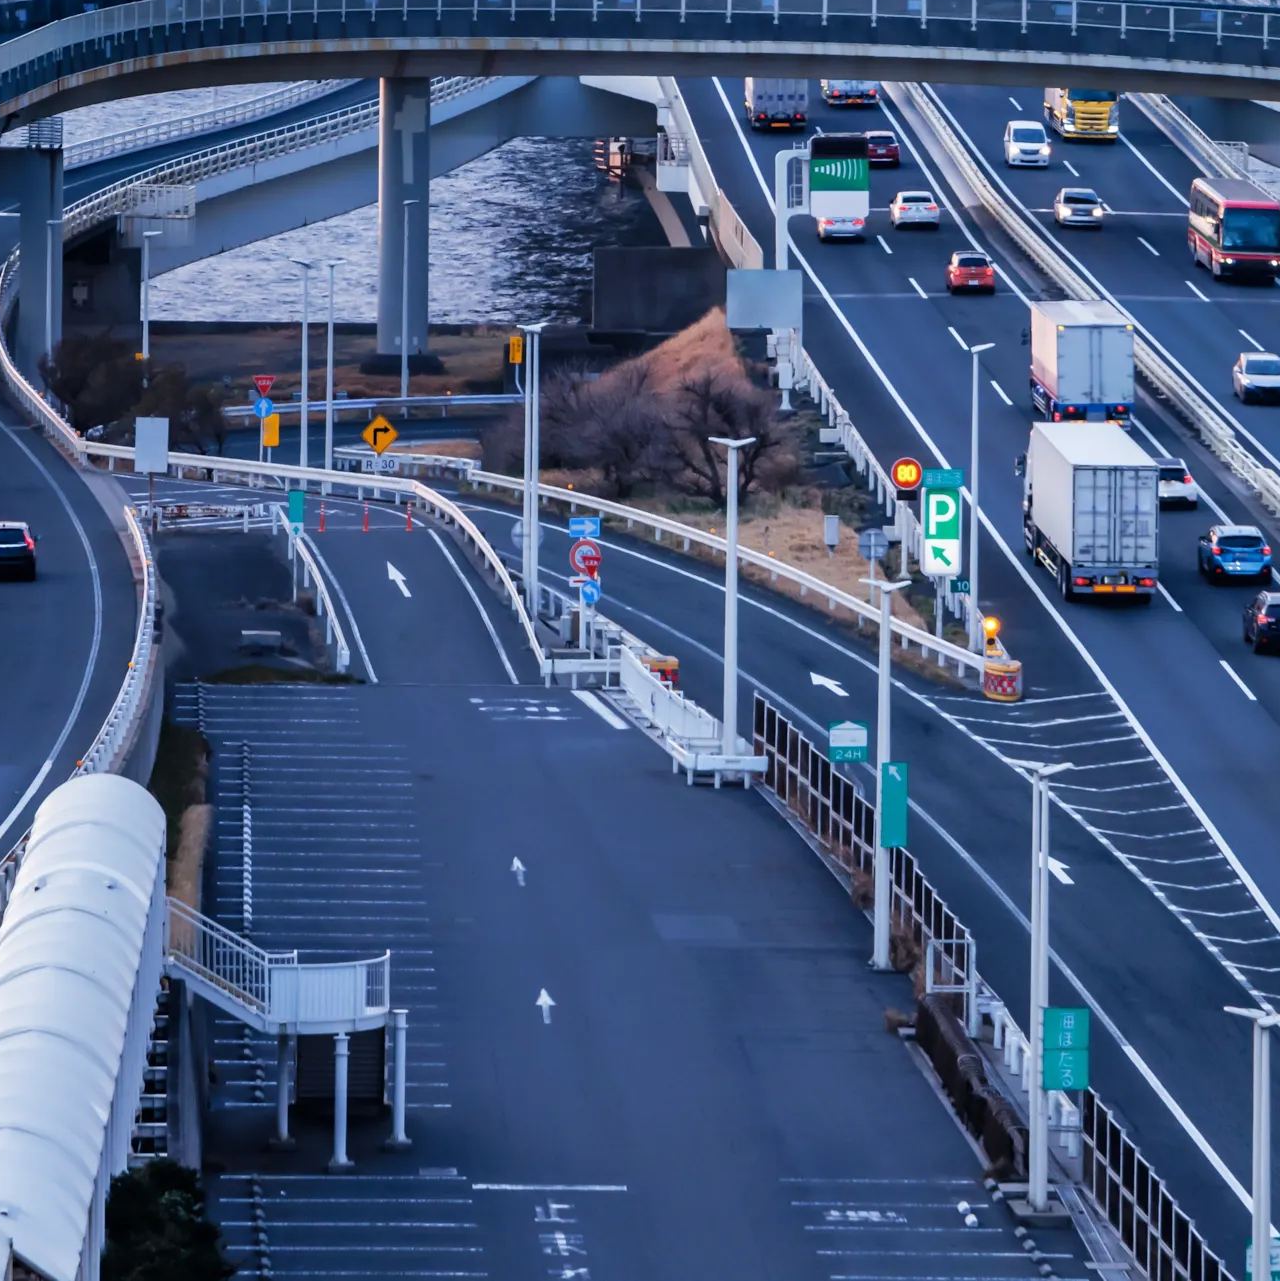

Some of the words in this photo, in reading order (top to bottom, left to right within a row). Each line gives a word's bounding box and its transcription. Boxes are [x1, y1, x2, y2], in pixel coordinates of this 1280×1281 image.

[896, 464, 917, 482] 80
[928, 493, 957, 535] P
[957, 581, 970, 592] 10
[835, 749, 862, 760] 24H
[1059, 1012, 1076, 1087] 海ほたる
